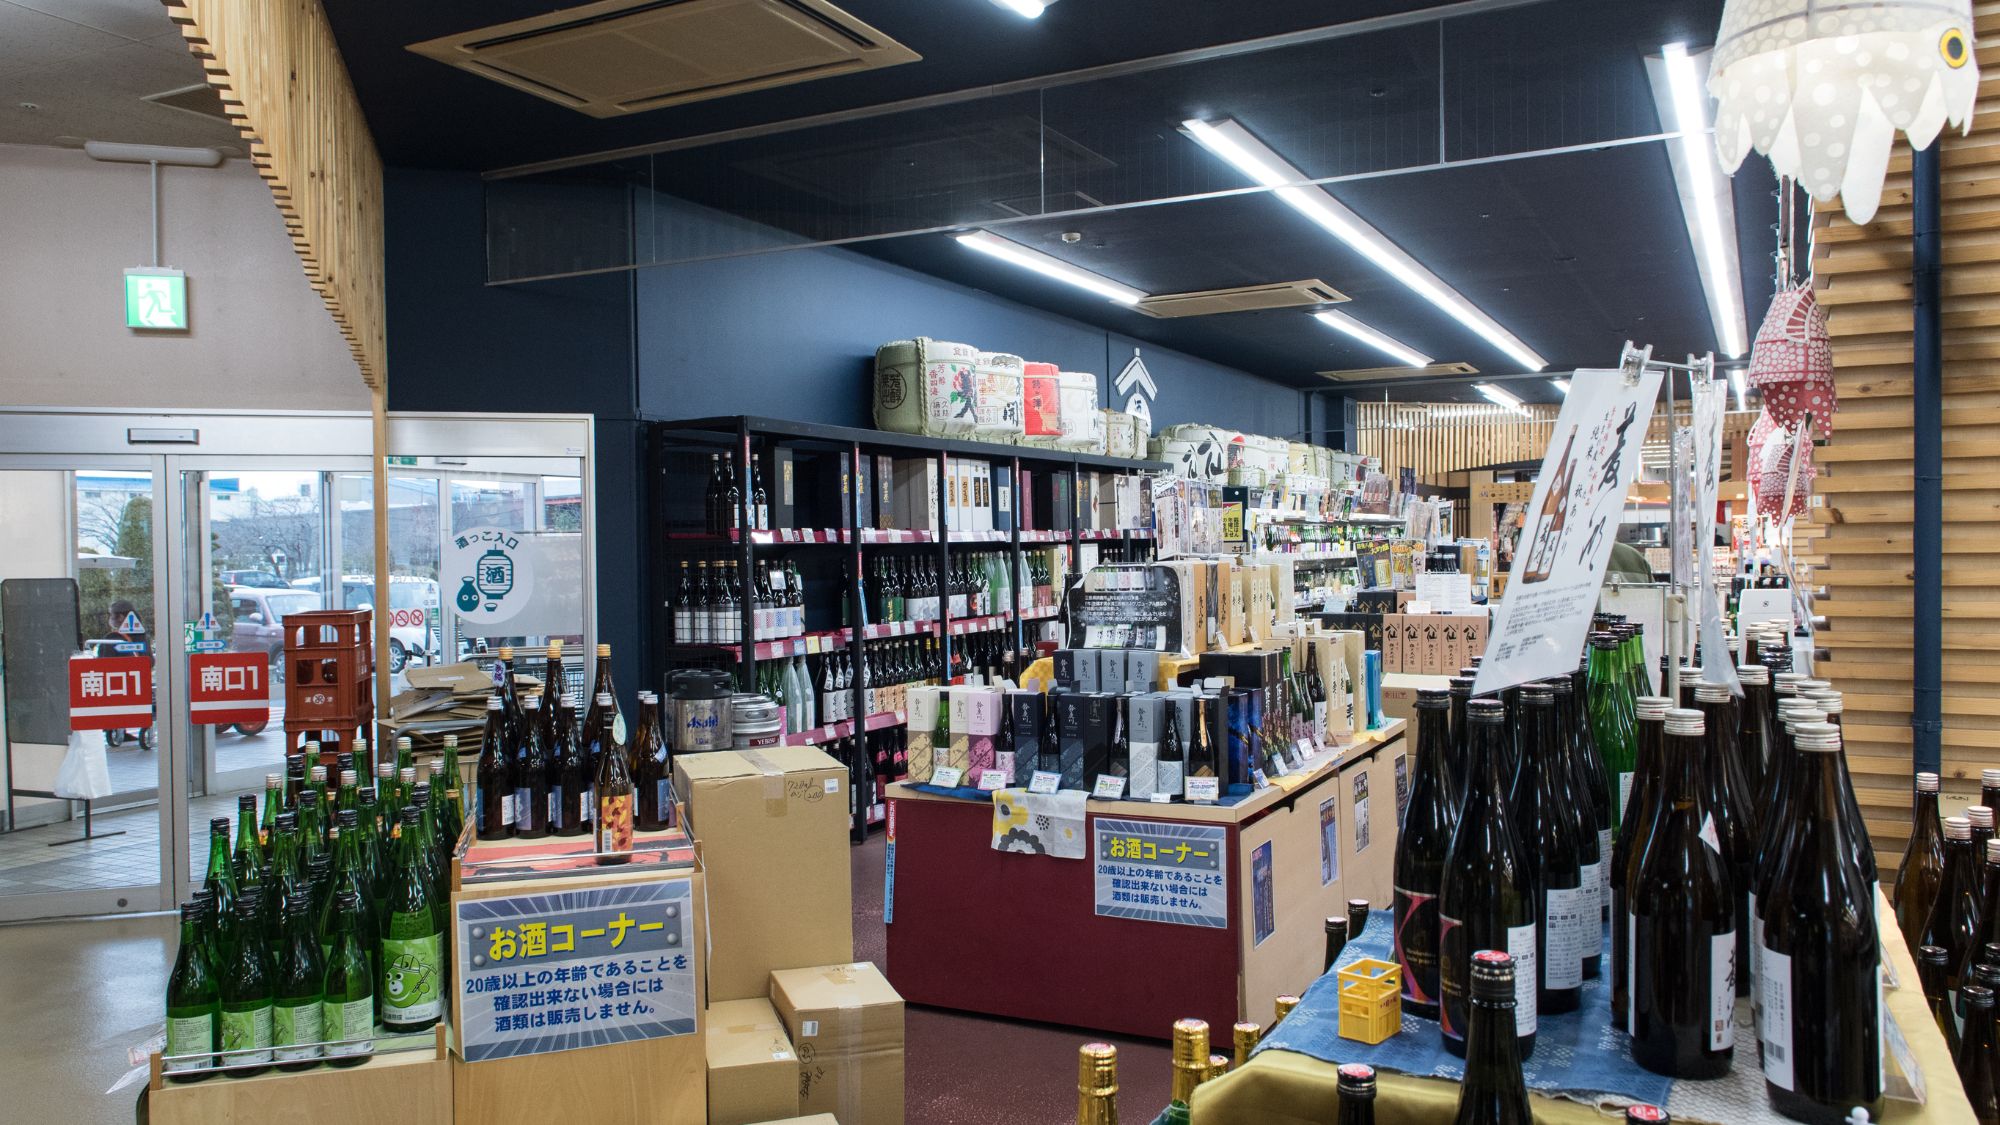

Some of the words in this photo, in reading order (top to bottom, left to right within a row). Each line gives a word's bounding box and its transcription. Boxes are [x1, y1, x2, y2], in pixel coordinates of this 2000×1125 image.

[455, 531, 519, 550] 酒っこ入口
[485, 566, 505, 584] 酒
[80, 670, 142, 698] 南口1
[200, 665, 259, 692] 南口1
[687, 714, 719, 729] Asahi
[1110, 836, 1209, 864] お酒コーナー
[1098, 864, 1223, 886] 20歳以上の年齢であることを
[1112, 878, 1208, 897] 確認出来ない場合には
[1112, 890, 1202, 910] 酒類は販売しません。
[488, 912, 665, 962] お酒コーナー
[466, 954, 688, 994] 20歳以上の年齢であることを
[493, 977, 664, 1013] 確認出来ない場合には
[494, 999, 656, 1033] 酒類は販売しません。
